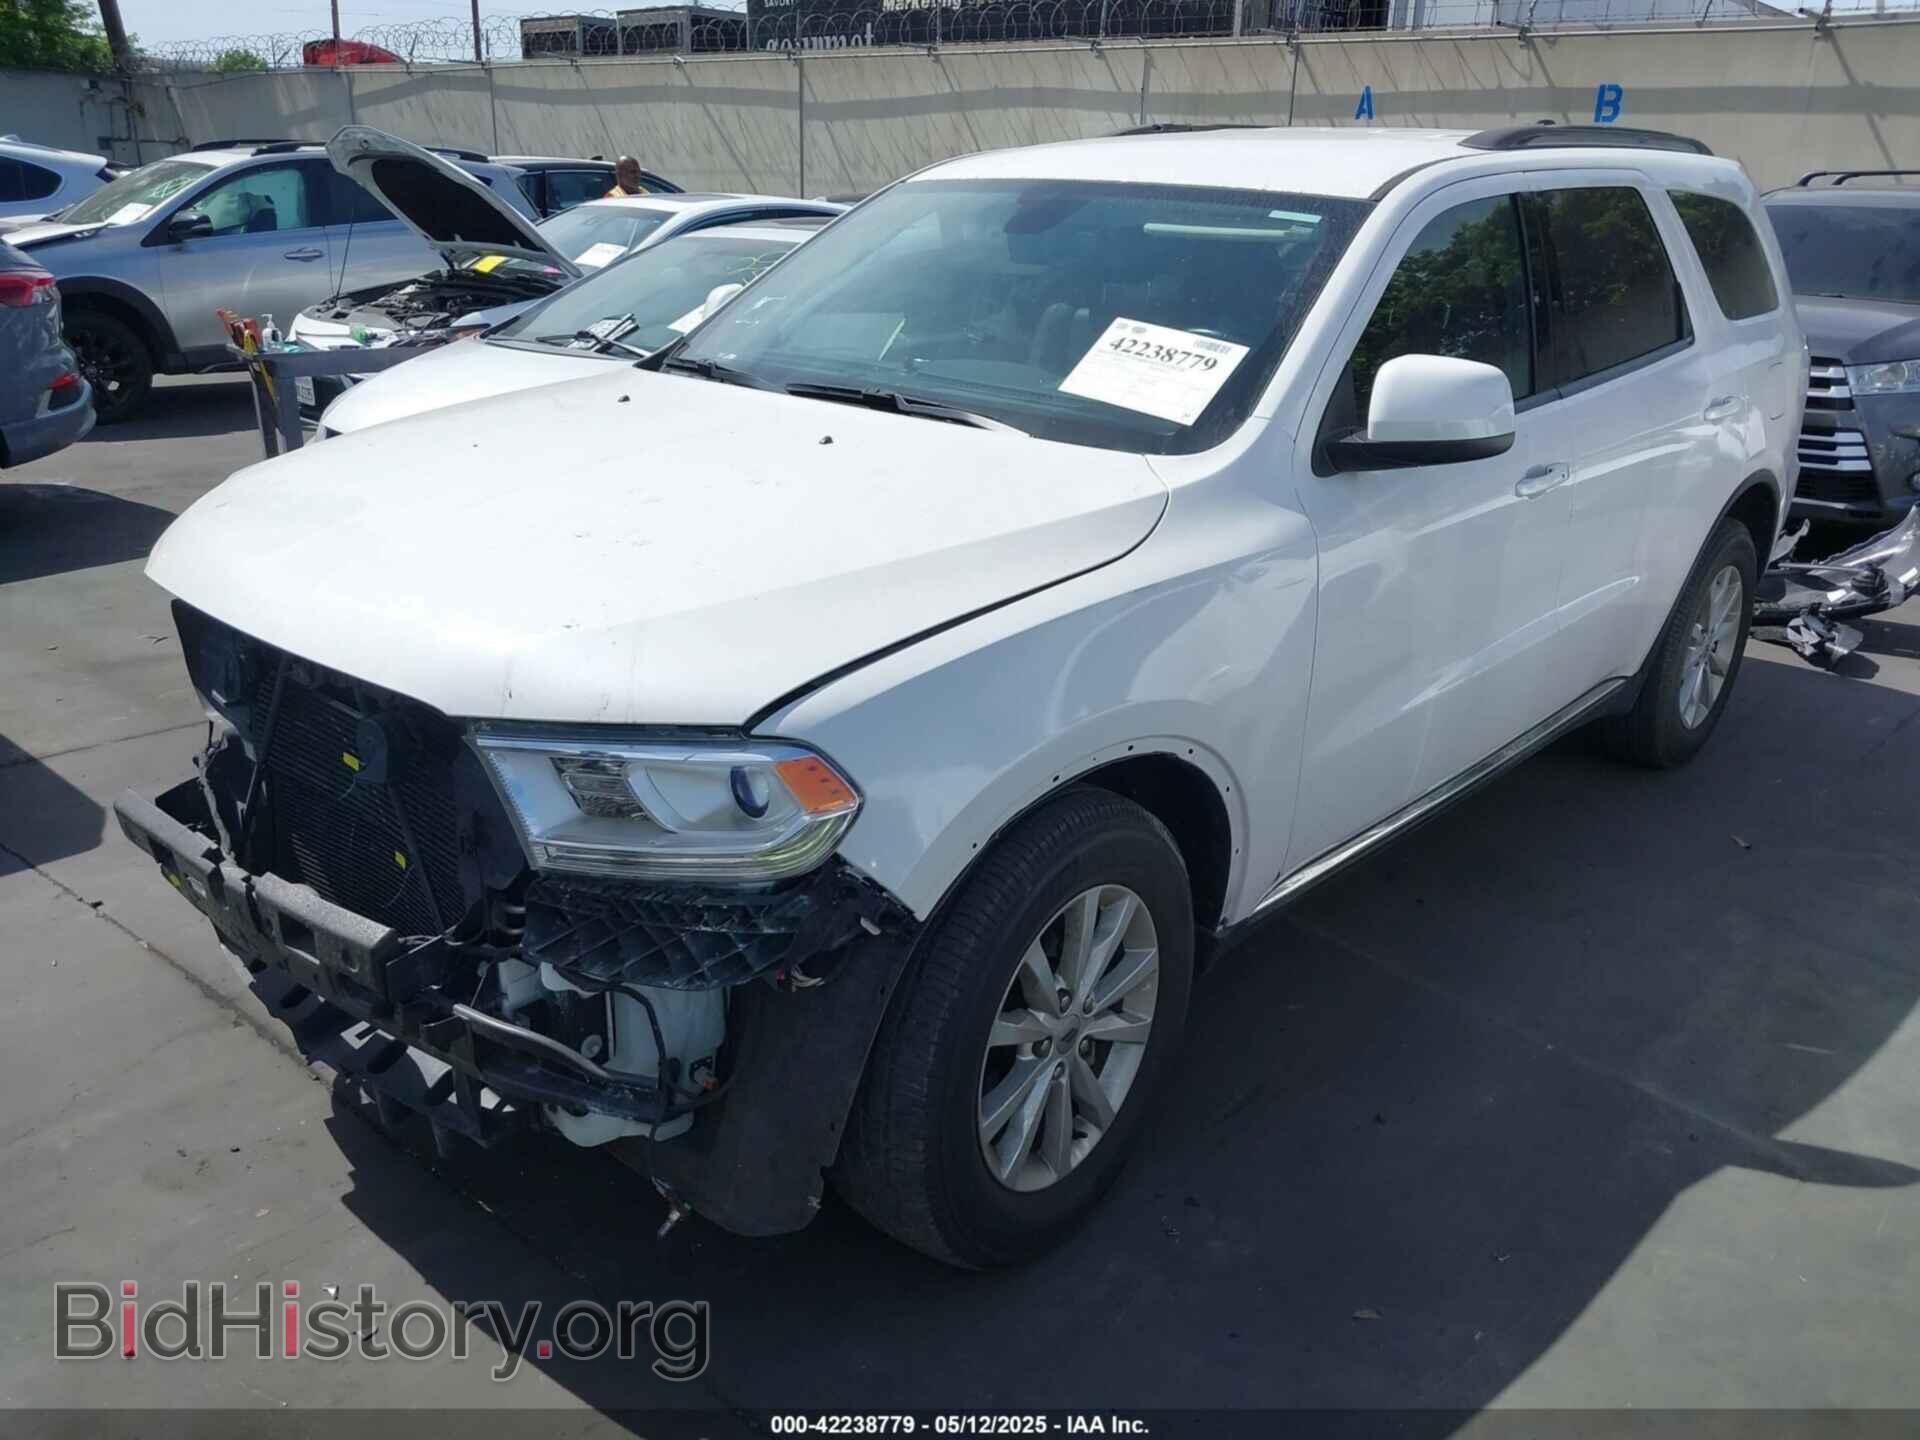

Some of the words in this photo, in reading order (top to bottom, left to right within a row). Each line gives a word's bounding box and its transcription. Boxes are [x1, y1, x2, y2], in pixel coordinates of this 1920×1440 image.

[1355, 86, 1375, 120] A
[1593, 84, 1624, 124] B
[1109, 336, 1218, 372] 42238779
